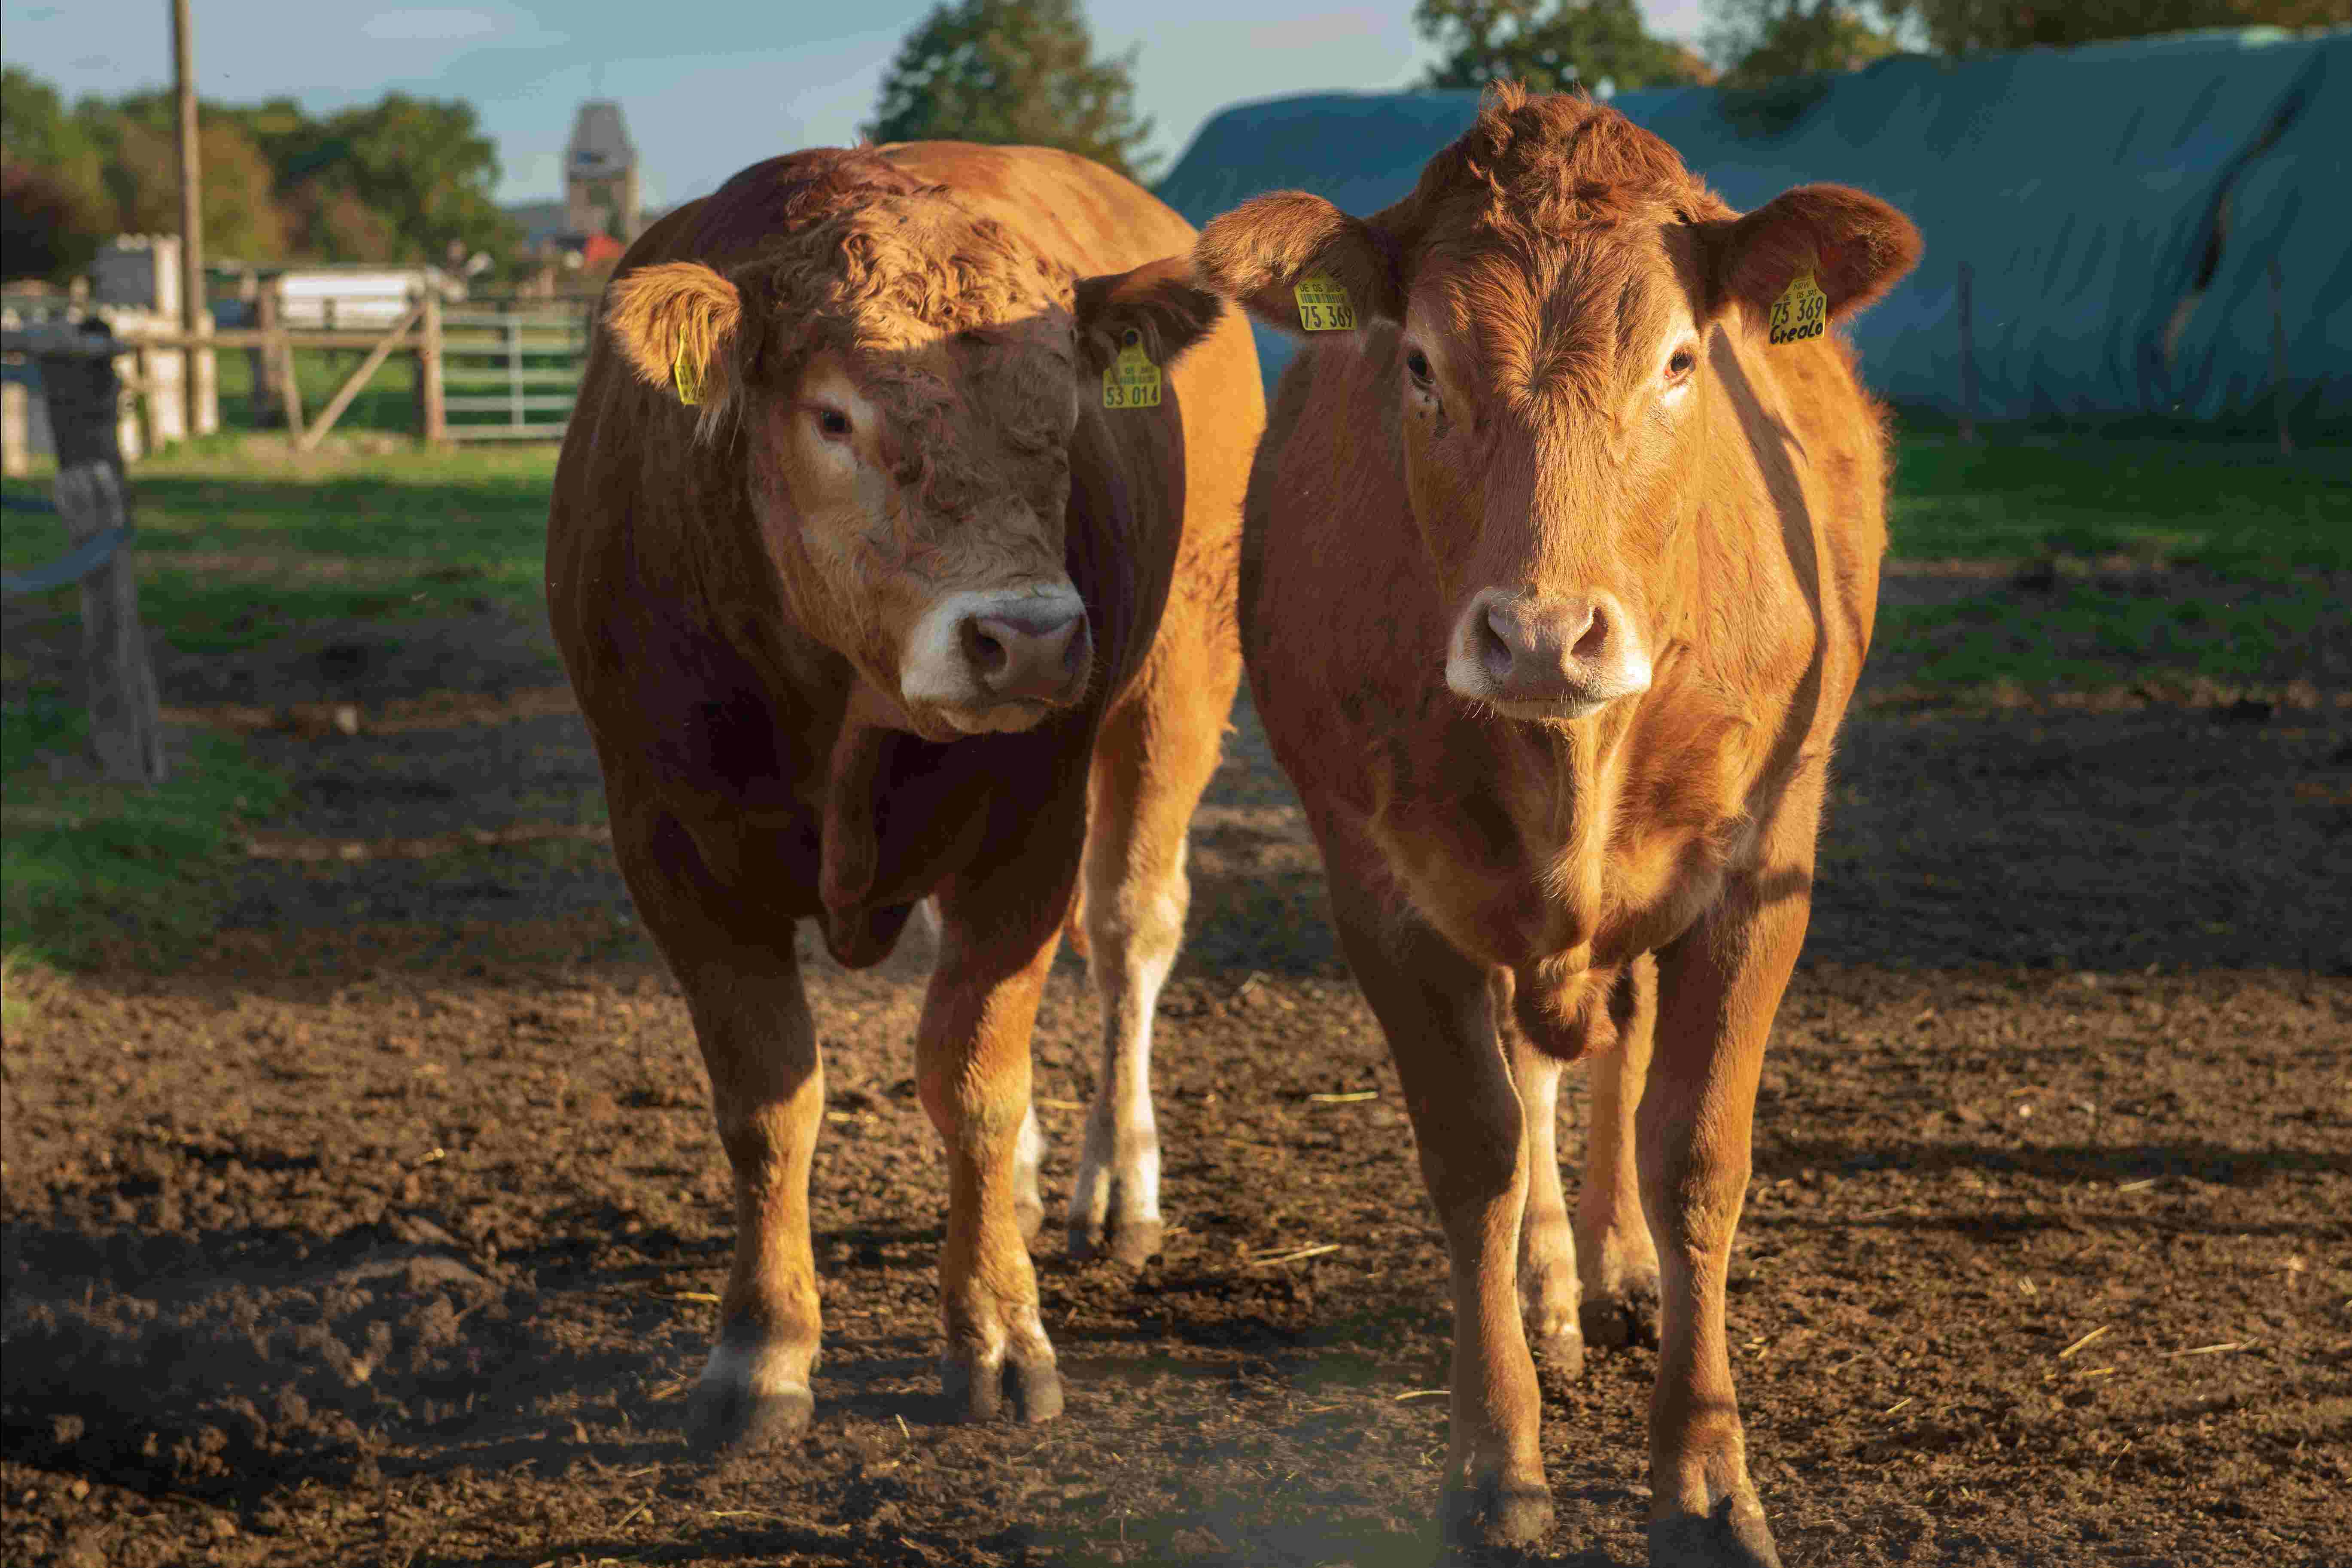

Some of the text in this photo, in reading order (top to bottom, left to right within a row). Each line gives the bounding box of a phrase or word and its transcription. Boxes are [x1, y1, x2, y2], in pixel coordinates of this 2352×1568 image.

[1301, 305, 1352, 328] 75 369
[1772, 296, 1823, 326] 75 369
[1106, 386, 1158, 406] 53 014
